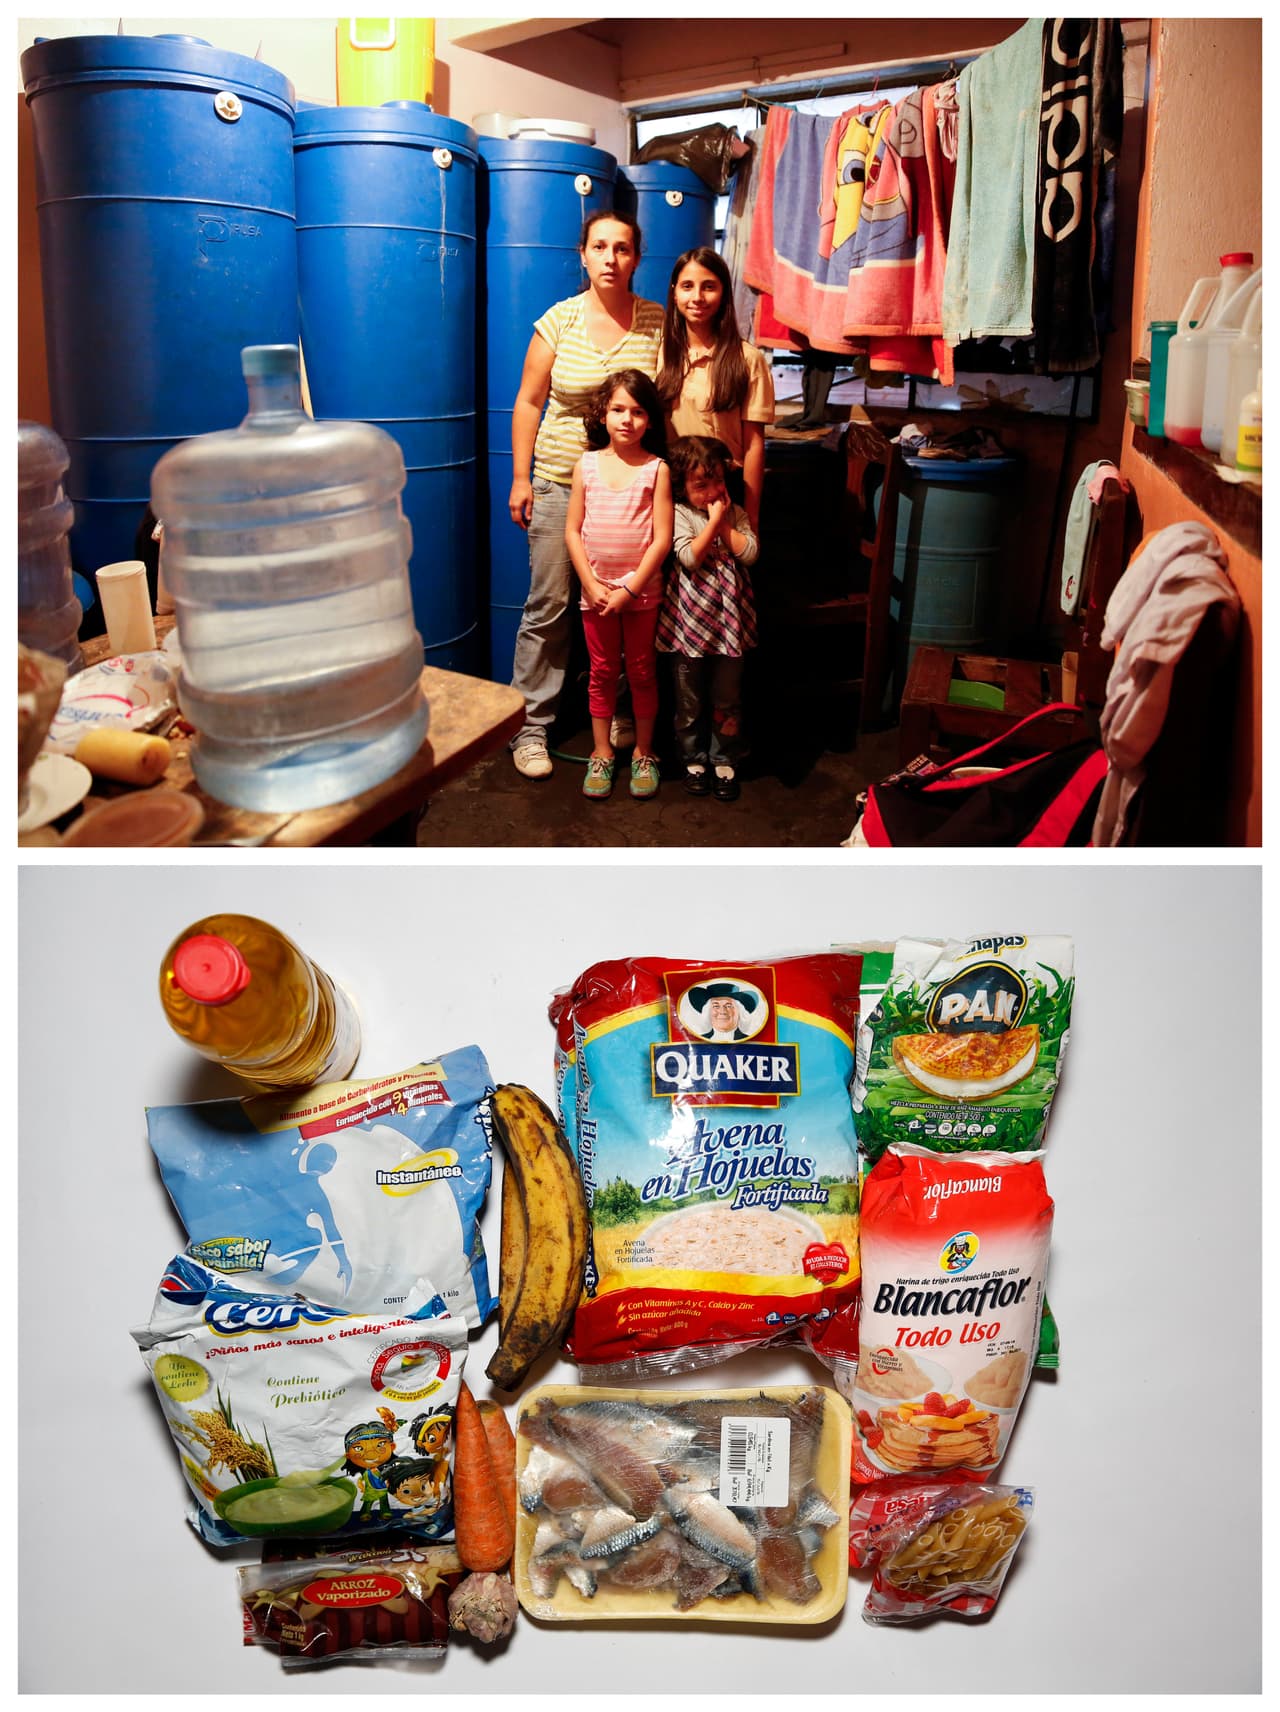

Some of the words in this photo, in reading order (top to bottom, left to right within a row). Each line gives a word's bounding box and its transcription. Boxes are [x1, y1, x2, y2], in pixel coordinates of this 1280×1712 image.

[656, 1051, 793, 1087] QUAKER
[319, 1099, 337, 1112] base
[337, 1095, 347, 1105] de
[336, 1104, 378, 1127] Enriquecido
[379, 1098, 392, 1108] con
[392, 1091, 402, 1104] 9
[397, 1103, 408, 1116] 4
[667, 1119, 784, 1166] Avena
[579, 1119, 598, 1209] Hojuelas
[642, 1173, 672, 1200] en
[672, 1147, 813, 1198] Hojuelas
[376, 1165, 464, 1185] Instantáneo
[731, 1182, 829, 1211] Fortificada
[923, 1176, 1002, 1200] Blancaflor
[226, 1238, 271, 1258] sabor
[624, 1246, 656, 1256] Hojuelas
[616, 1256, 653, 1264] Fortificada
[896, 1278, 920, 1286] Harina
[931, 1276, 950, 1286] trigo
[950, 1272, 991, 1285] enriquecida
[992, 1270, 1008, 1279] Todo
[1008, 1267, 1020, 1276] Uso
[383, 1296, 408, 1305] CONTE
[628, 1301, 643, 1310] Con
[644, 1299, 684, 1308] Vitaminas
[708, 1301, 731, 1309] Calcio
[738, 1302, 756, 1310] Zinc
[873, 1276, 1032, 1317] Blancaflor
[628, 1312, 641, 1321] Sin
[641, 1310, 669, 1319] azúcar
[895, 1326, 953, 1348] Todo
[959, 1321, 1001, 1345] Uso
[205, 1346, 249, 1360] ¡Niños
[253, 1340, 282, 1352] más
[286, 1336, 324, 1346] sanos
[327, 1333, 336, 1341] e
[267, 1375, 320, 1387] Contiene
[271, 1387, 346, 1409] Prebiótico
[331, 1578, 377, 1591] ARROZ
[316, 1587, 391, 1603] Vaporizado
